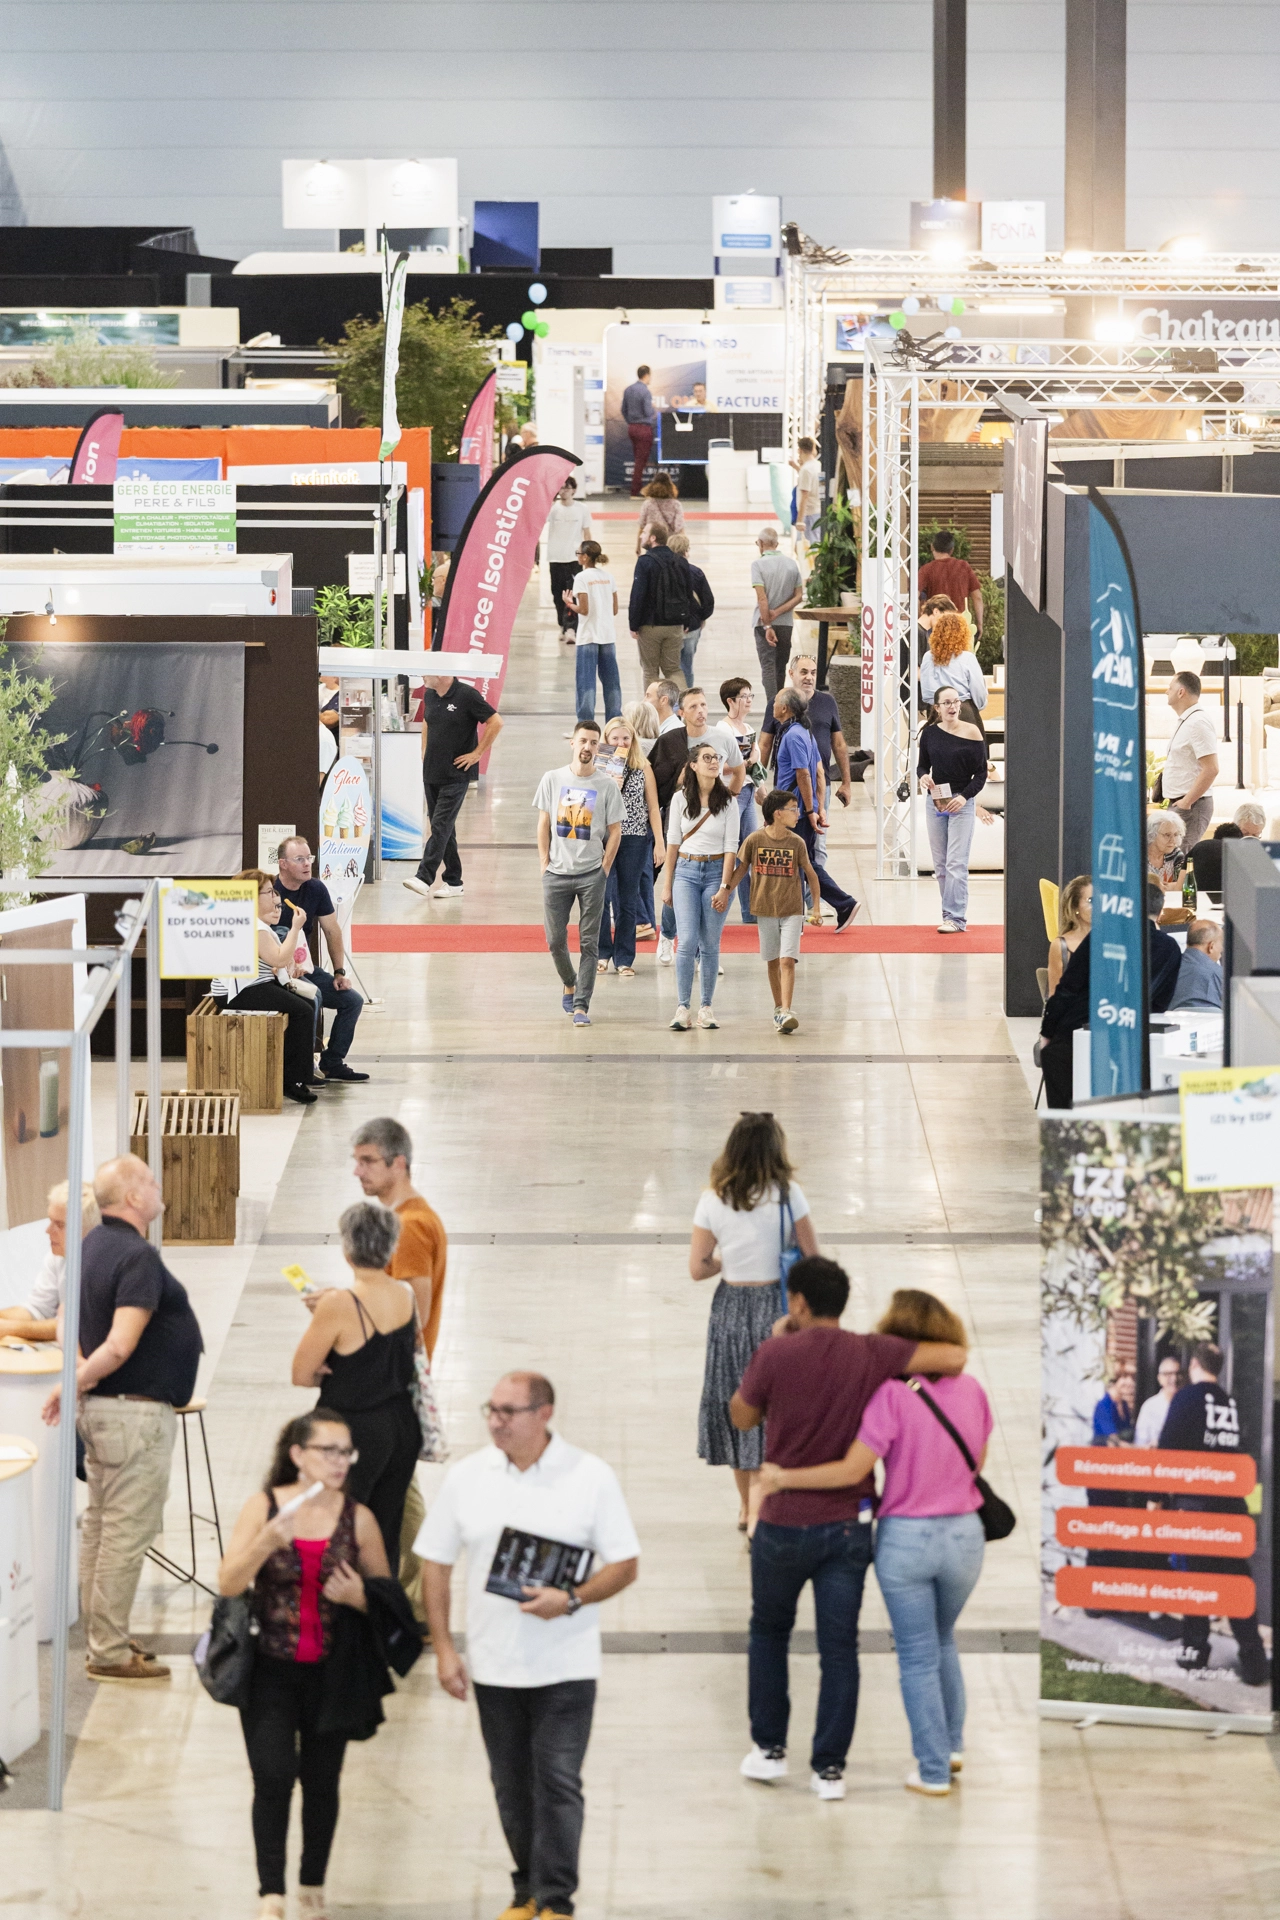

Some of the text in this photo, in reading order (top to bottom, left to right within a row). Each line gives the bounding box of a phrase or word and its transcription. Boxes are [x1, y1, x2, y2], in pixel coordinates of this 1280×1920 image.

[990, 222, 1037, 240] FONTA
[717, 396, 779, 408] FACTURE
[81, 441, 100, 484] ion
[117, 482, 233, 496] GERS ÉCO ENERGIE
[134, 498, 216, 508] PERE & FILS
[477, 476, 531, 593] Isolation
[861, 604, 875, 714] CEREZO
[333, 769, 361, 795] Glace
[321, 839, 362, 856] Italienne
[759, 848, 792, 858] STAR
[759, 857, 792, 866] WARS
[167, 917, 250, 926] EDF SOLUTIONS
[183, 930, 235, 939] SOLAIRES
[1072, 1152, 1127, 1199] izi
[1204, 1392, 1240, 1432] izi
[1073, 1459, 1236, 1484] Rénovation énergétique
[1067, 1519, 1243, 1543] Chauffage & climatisation
[1091, 1581, 1219, 1604] Mobilité électrique
